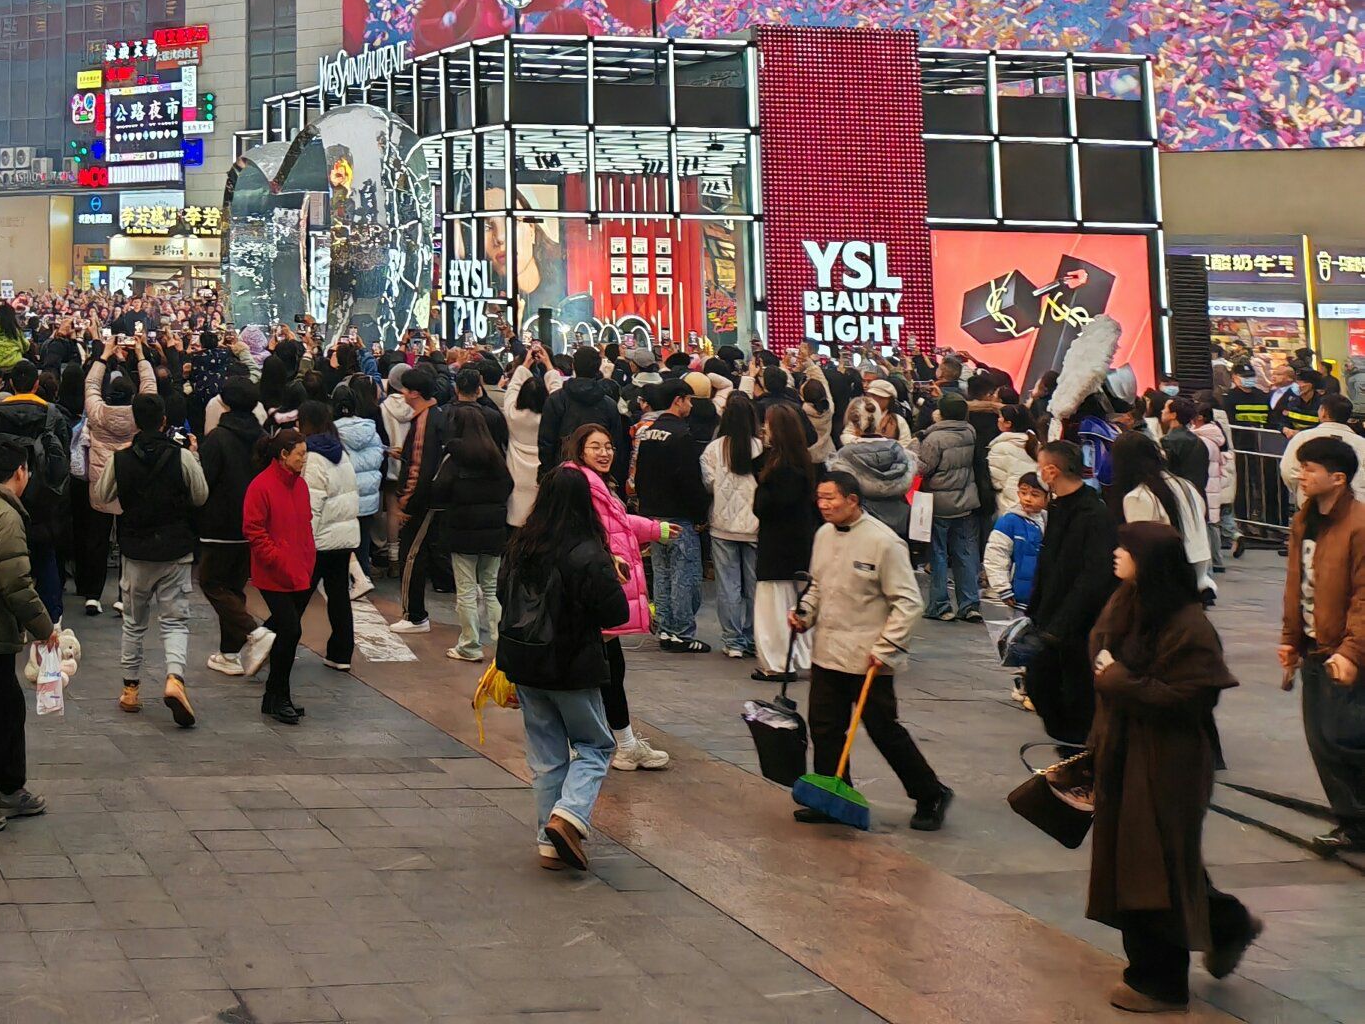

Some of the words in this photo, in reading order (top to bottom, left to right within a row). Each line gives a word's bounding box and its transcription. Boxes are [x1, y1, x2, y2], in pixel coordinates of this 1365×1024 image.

[114, 97, 180, 122] 公路夜市
[449, 259, 494, 297] #YSL
[803, 241, 902, 289] YSL
[804, 291, 903, 313] BEAUTY
[805, 315, 904, 343] LIGHT
